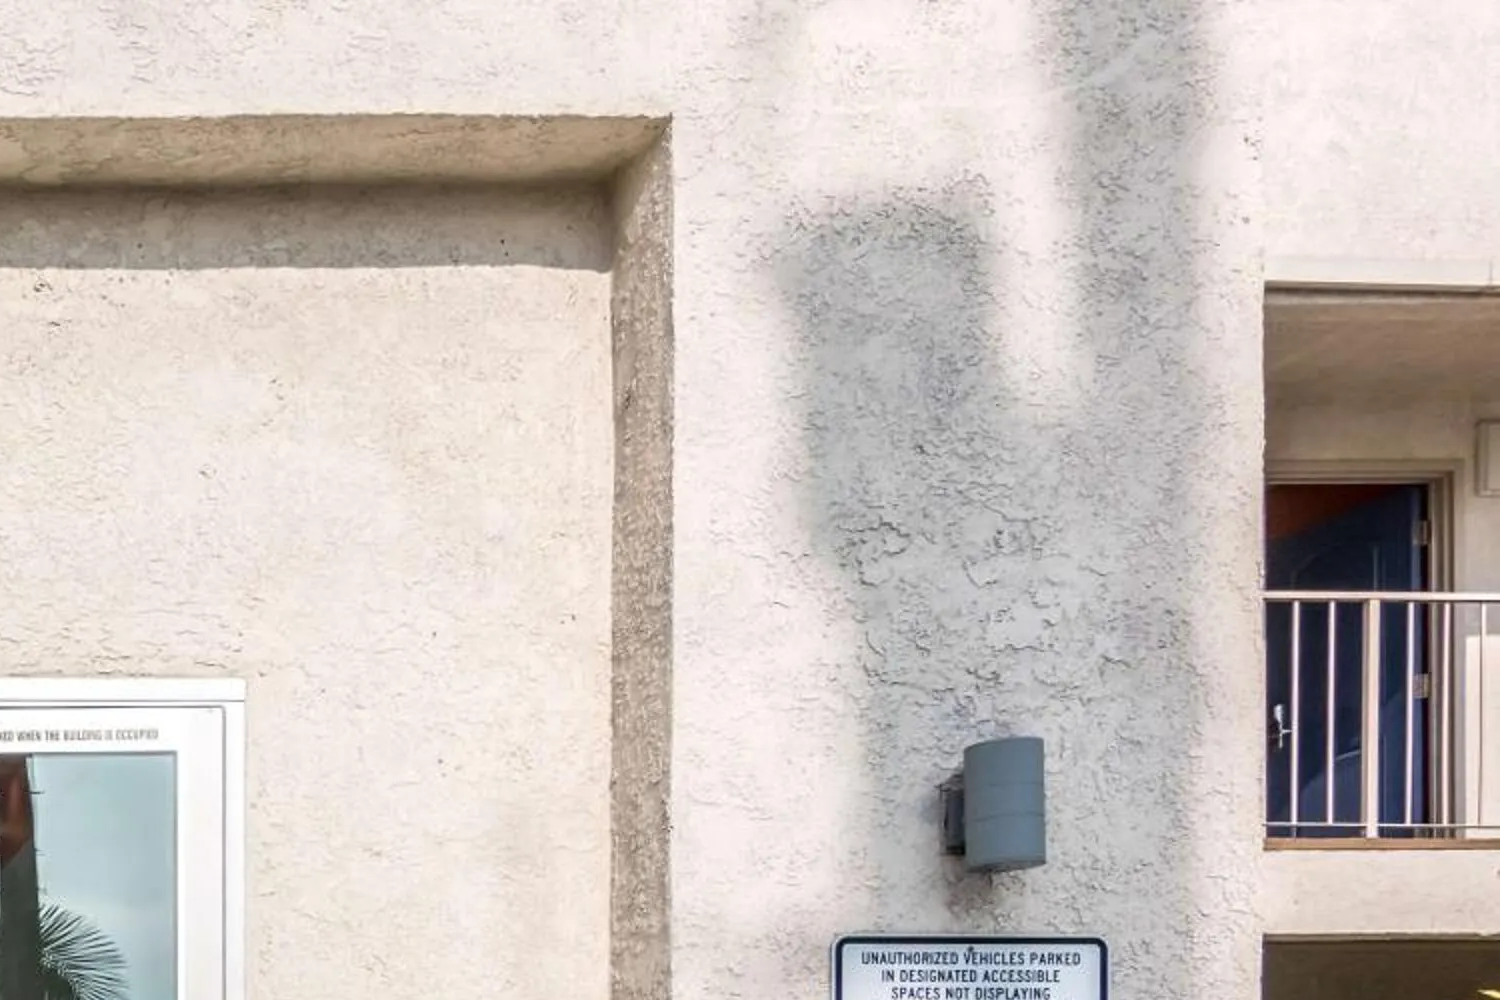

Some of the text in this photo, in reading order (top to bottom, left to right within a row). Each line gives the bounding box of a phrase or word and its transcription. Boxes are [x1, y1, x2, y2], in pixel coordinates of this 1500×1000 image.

[17, 730, 42, 741] WHEN
[45, 730, 60, 741] THE
[862, 952, 1081, 966] UNAUTHORIZED VEHICLES PARKED
[882, 970, 1061, 983] IN DESIGNATED ACCESSIBLE
[891, 988, 1052, 1000] SPACES NOT DISPLAYING
